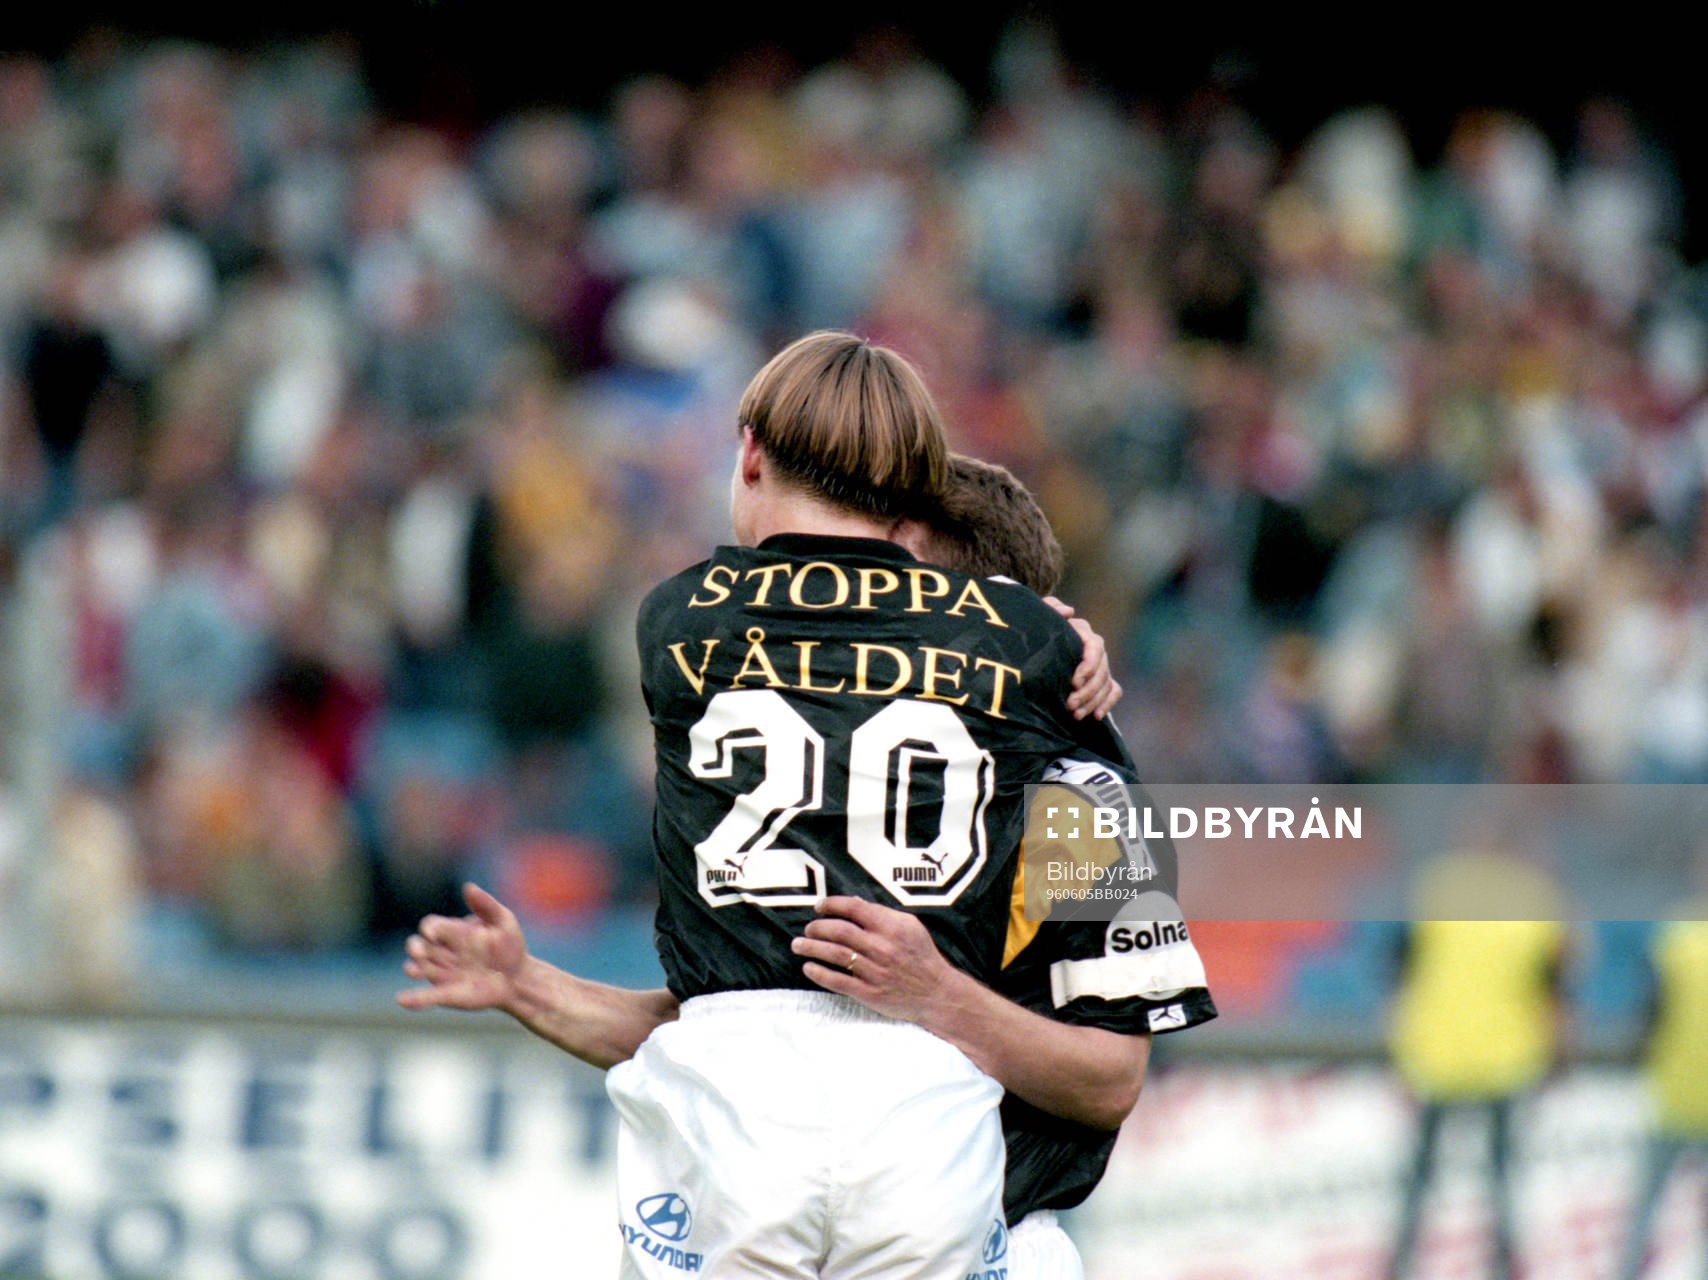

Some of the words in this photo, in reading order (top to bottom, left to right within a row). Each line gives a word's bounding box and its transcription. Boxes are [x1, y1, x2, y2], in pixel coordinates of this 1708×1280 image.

[688, 561, 1009, 628] STOPPA
[667, 626, 1022, 719] VÅLDET
[688, 689, 995, 907] 20
[892, 867, 936, 881] PUMA
[1111, 921, 1188, 953] Solna
